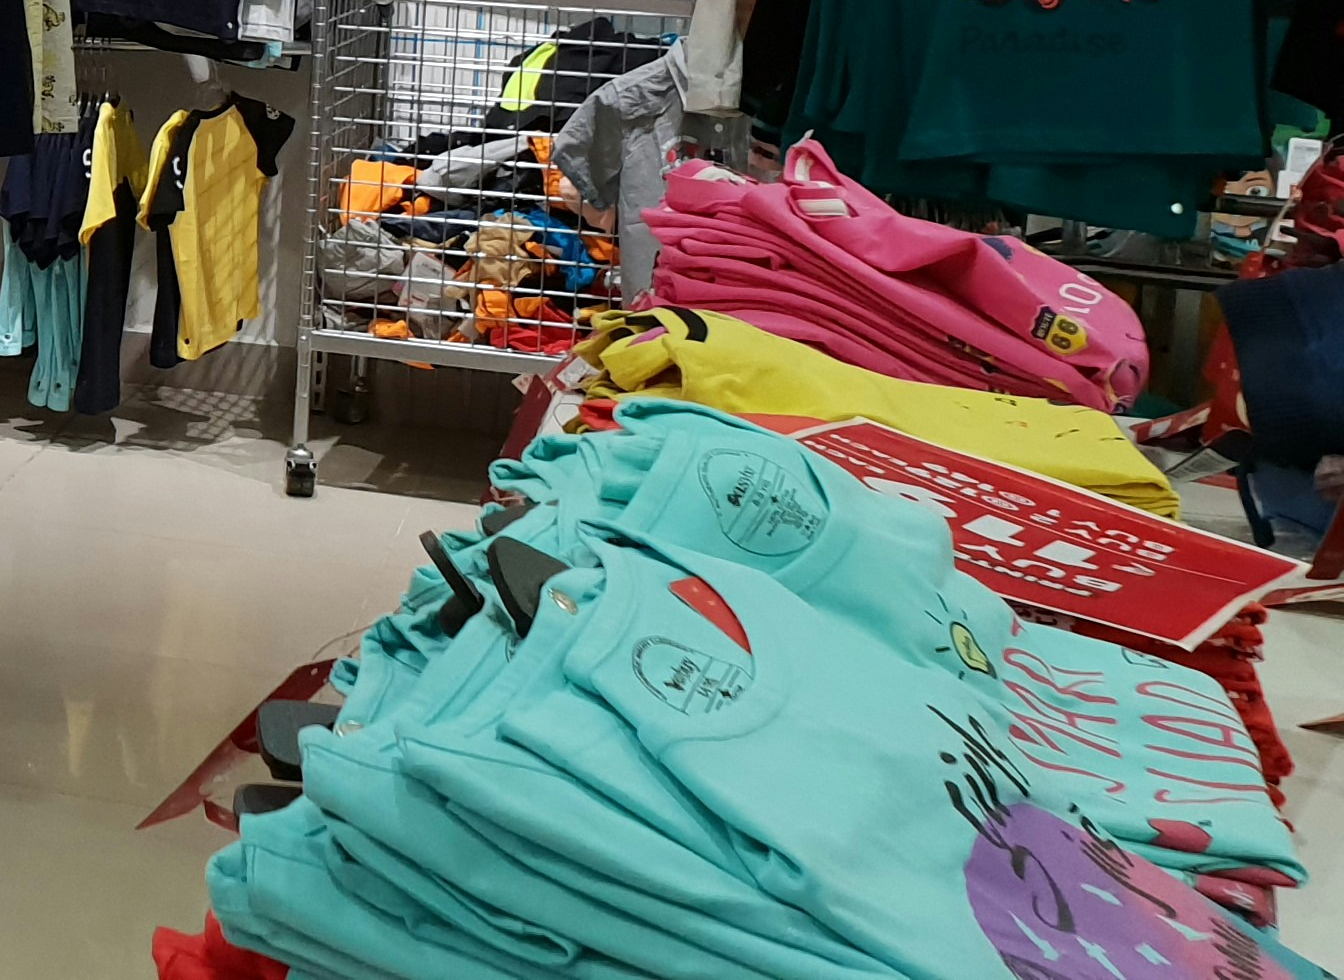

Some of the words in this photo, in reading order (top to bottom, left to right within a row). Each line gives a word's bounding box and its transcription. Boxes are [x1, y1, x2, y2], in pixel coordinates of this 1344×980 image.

[1064, 528, 1168, 561] BUY
[1071, 521, 1175, 553] BUY
[958, 543, 1123, 593] BUY
